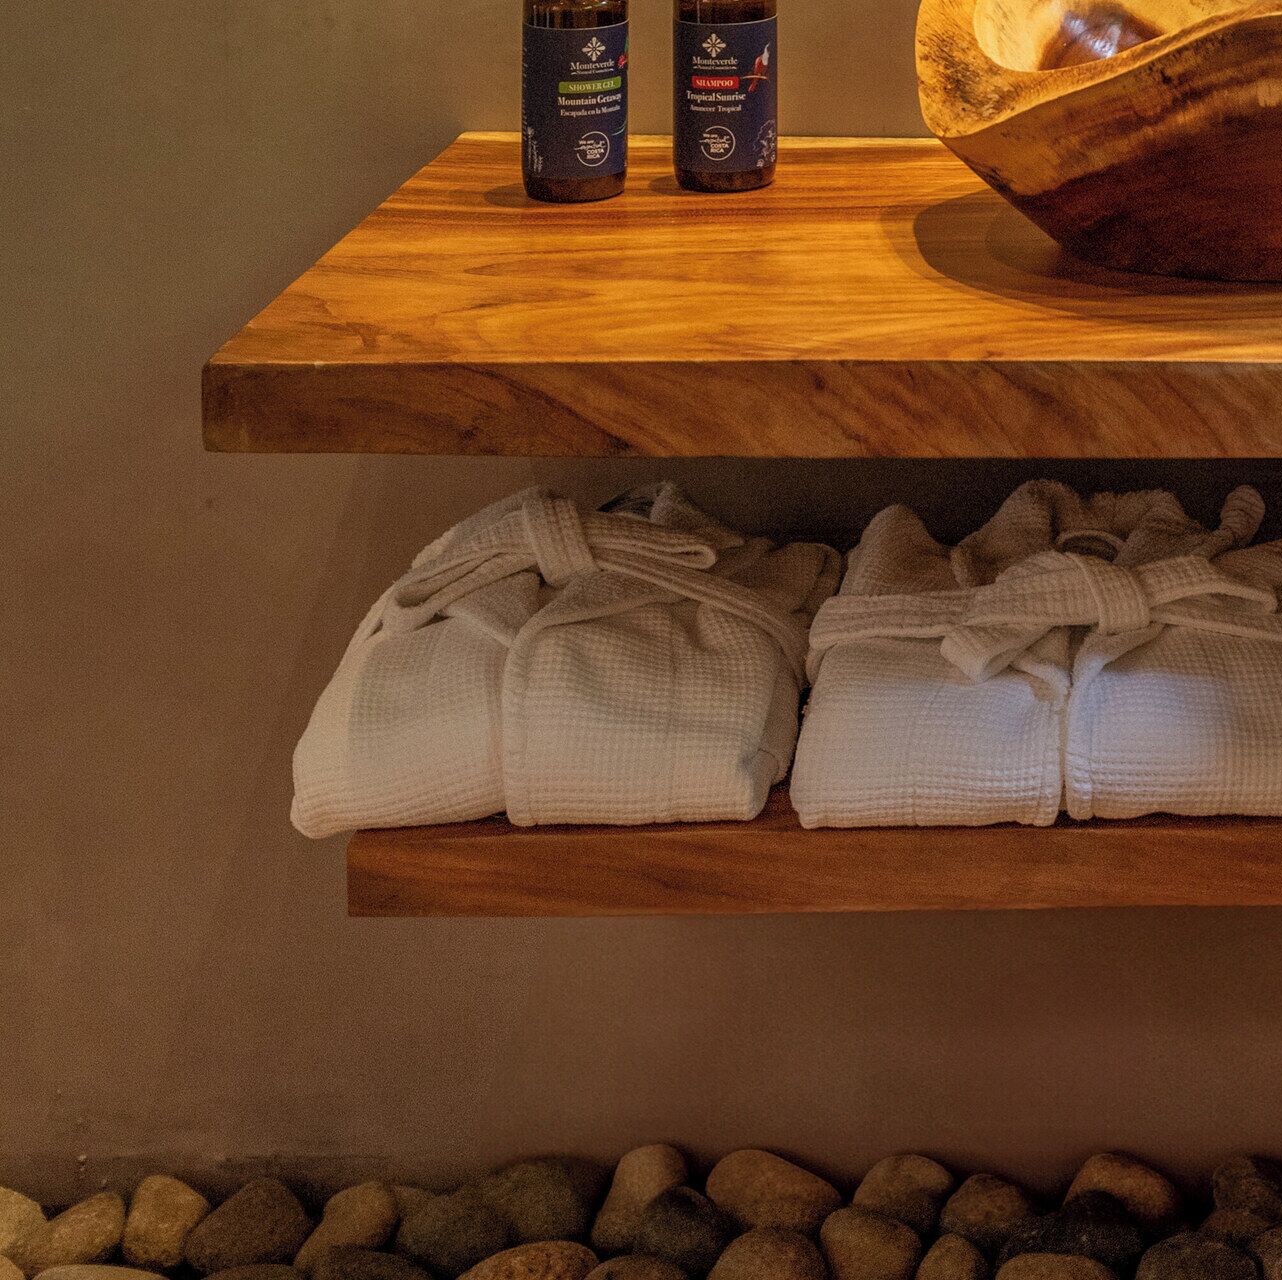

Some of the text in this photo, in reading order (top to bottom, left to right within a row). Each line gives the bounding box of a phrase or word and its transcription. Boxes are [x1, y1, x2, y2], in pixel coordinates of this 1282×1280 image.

[570, 59, 614, 70] Monteverde
[692, 56, 738, 65] Monteverde
[568, 80, 615, 91] SHOWER GEL
[696, 79, 733, 87] SHAMPOO
[558, 93, 621, 105] Mountain Getaway
[686, 90, 746, 103] Tropical Sunrise
[560, 109, 587, 118] Escapada
[717, 104, 742, 113] Tropical
